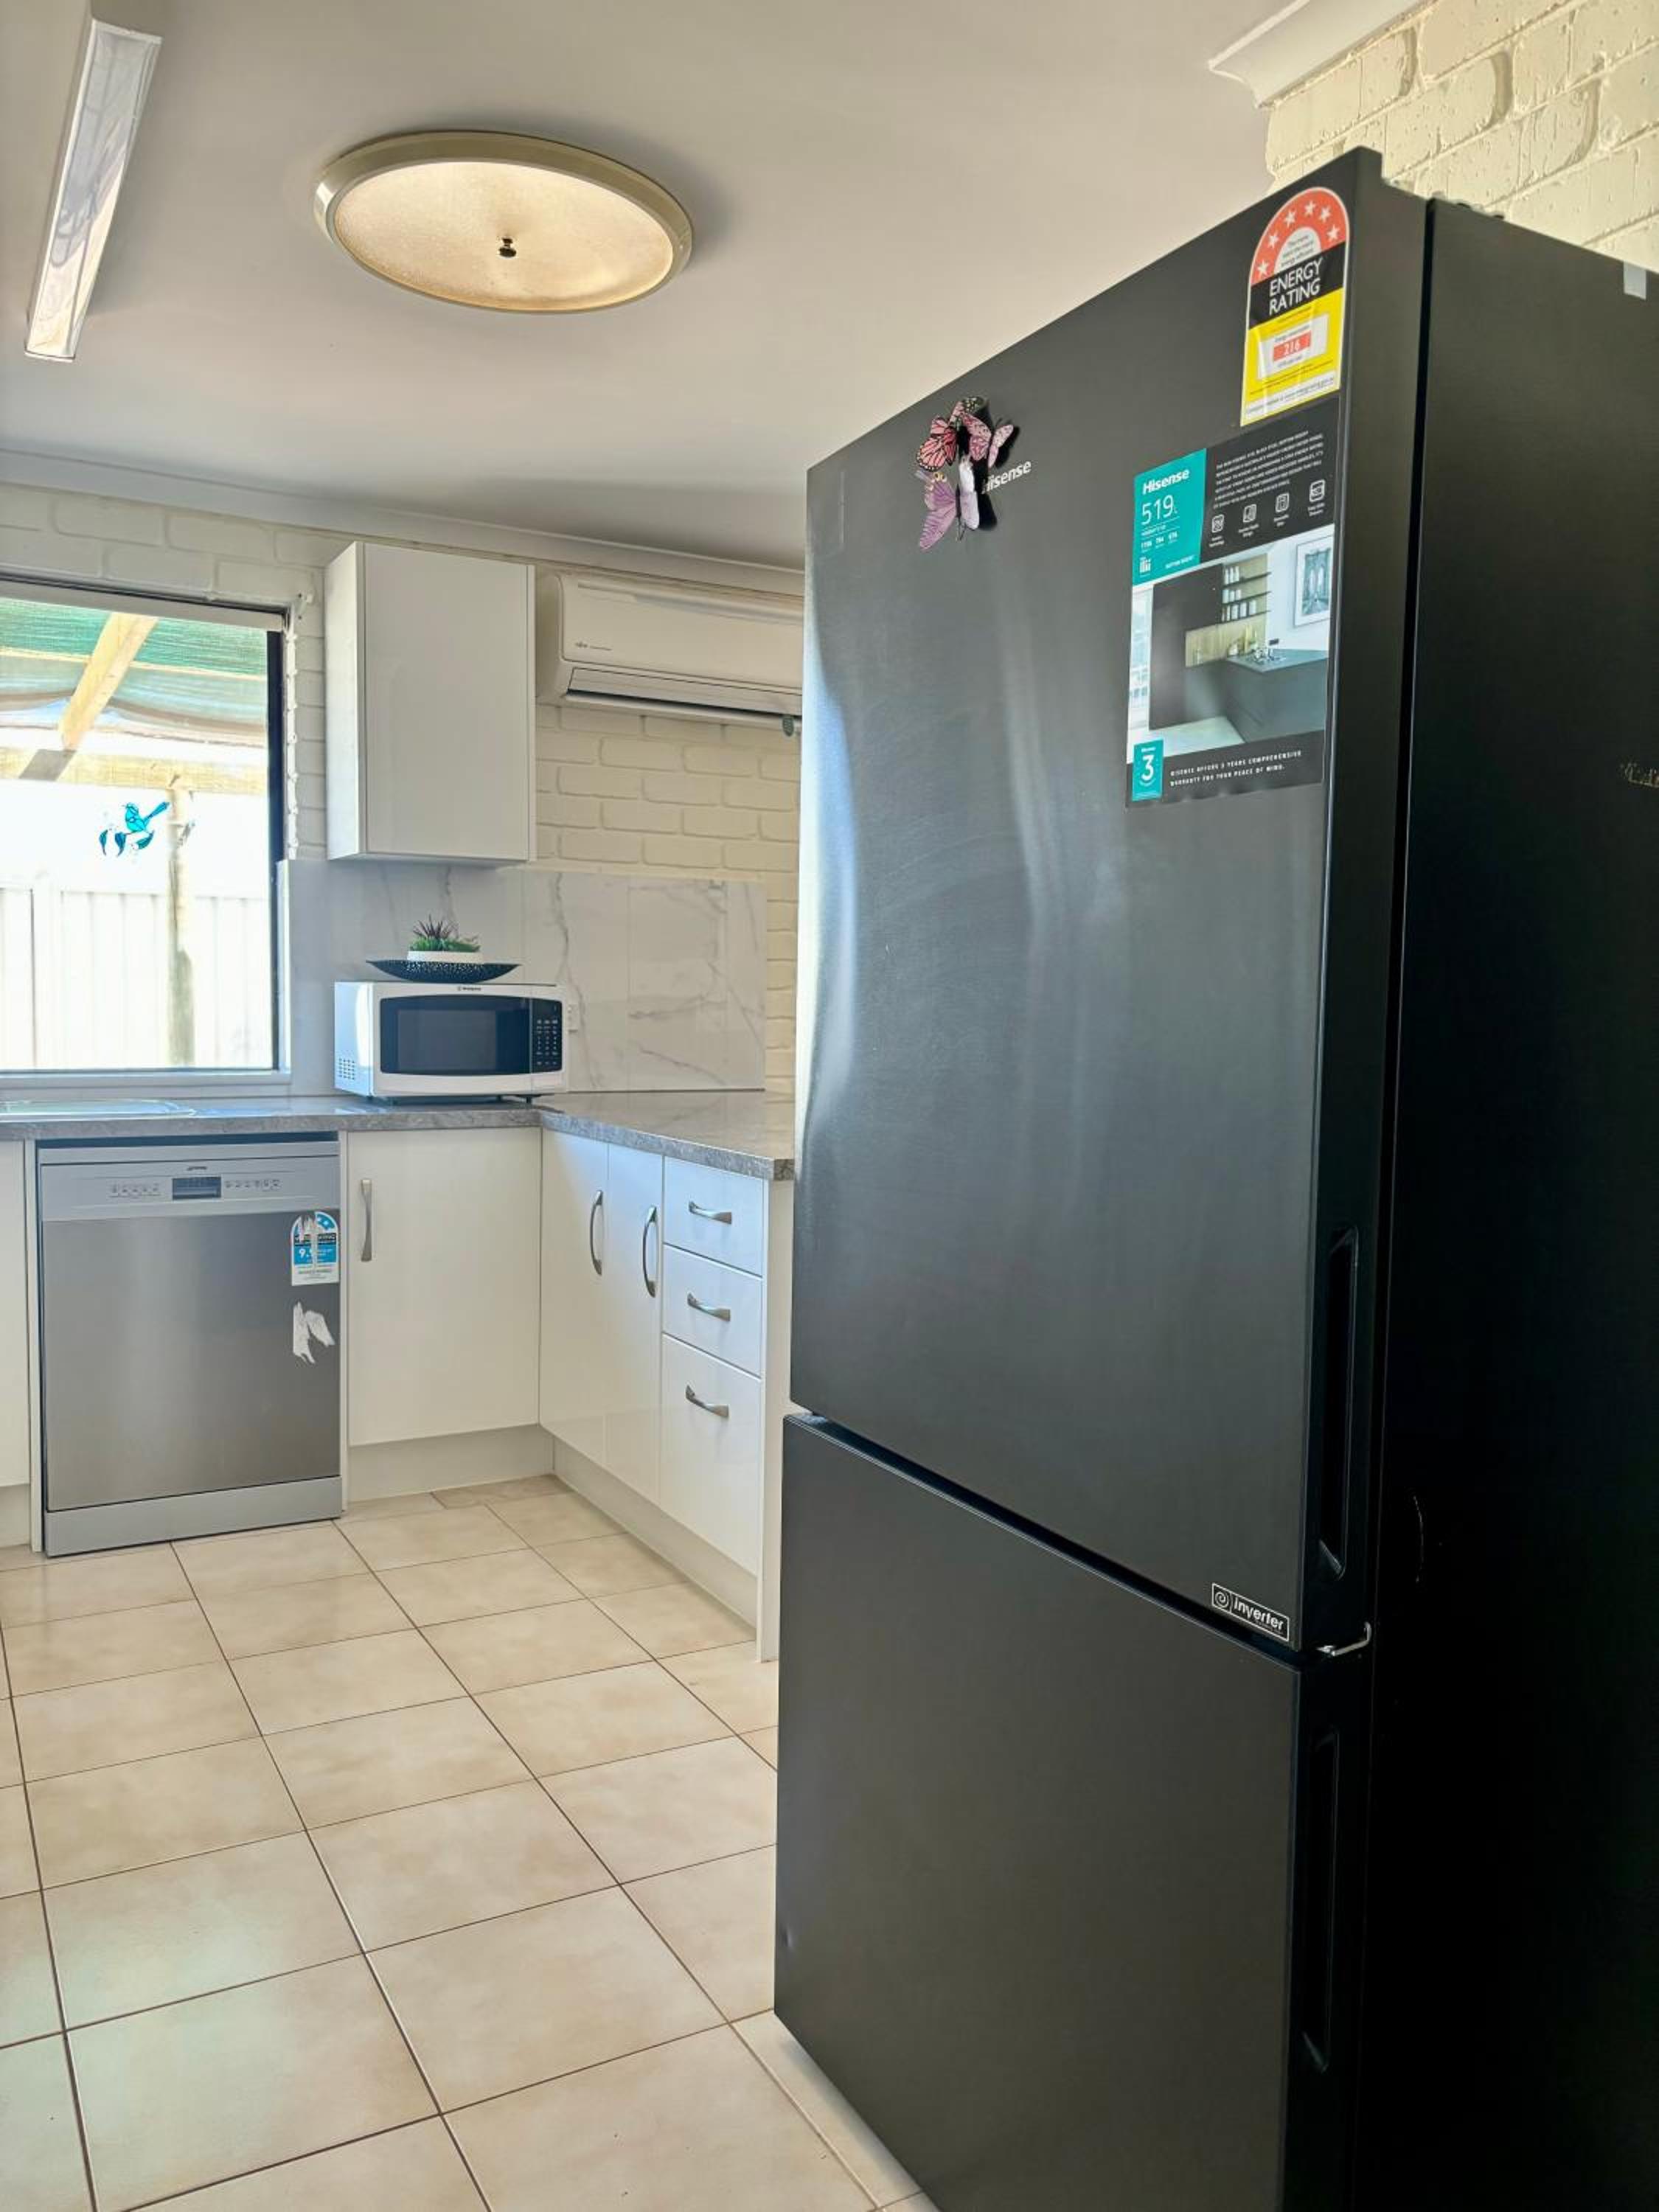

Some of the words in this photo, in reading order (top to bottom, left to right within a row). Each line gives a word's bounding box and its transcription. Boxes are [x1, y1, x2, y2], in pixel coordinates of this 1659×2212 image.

[1270, 257, 1323, 297] ENERGY
[1270, 278, 1321, 316] RATING
[1142, 469, 1190, 495] Hisense
[1141, 754, 1155, 781] 3
